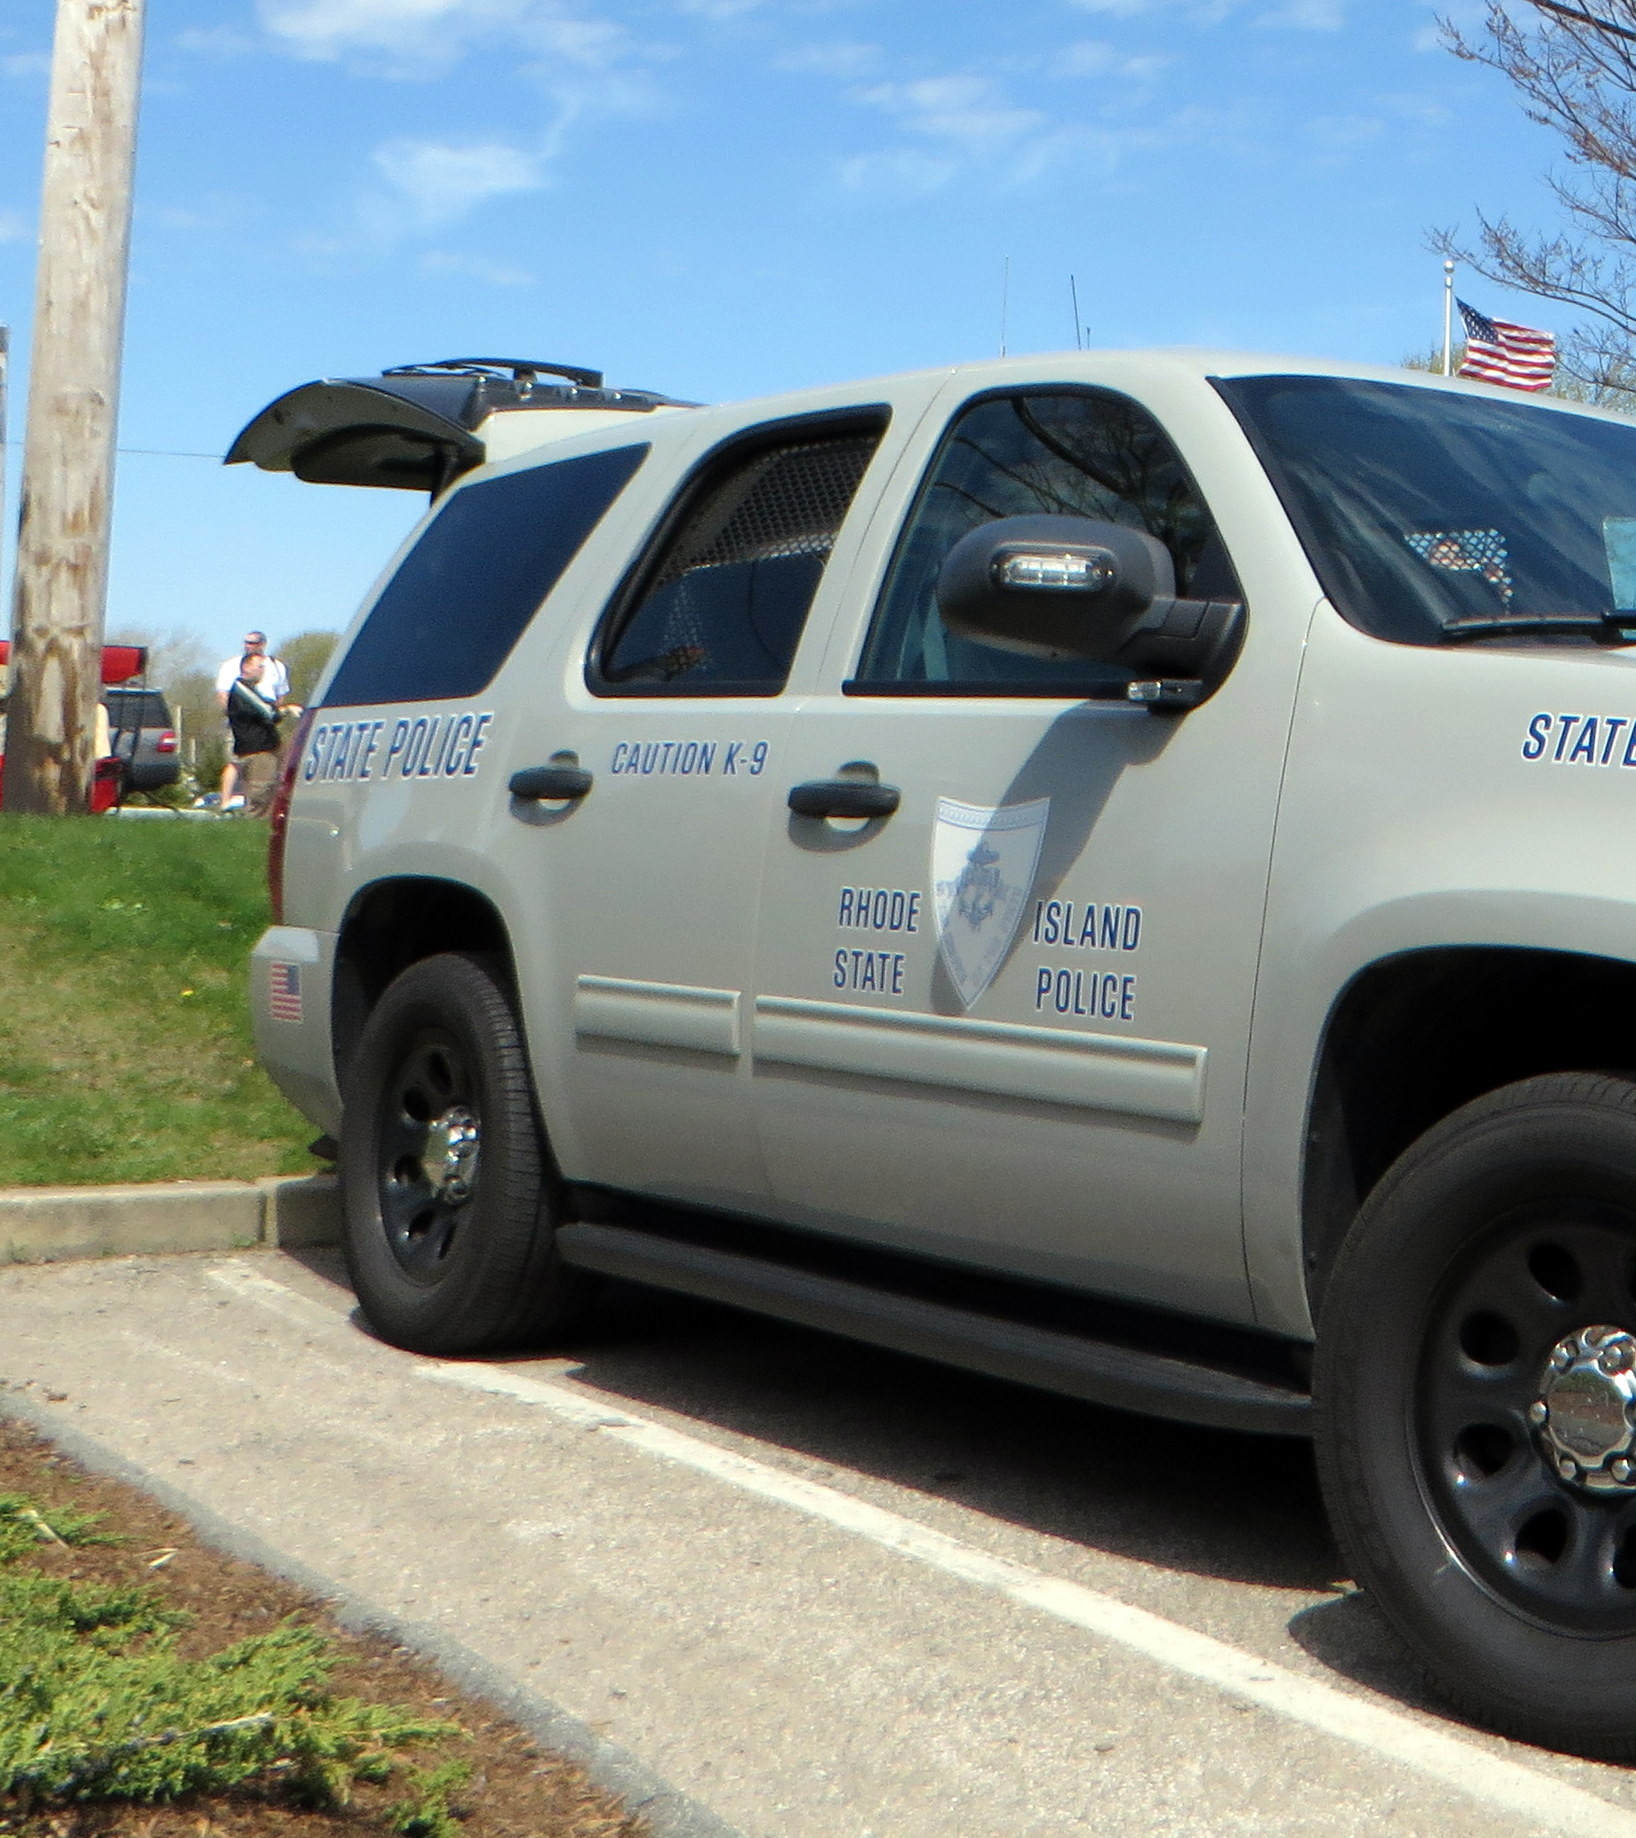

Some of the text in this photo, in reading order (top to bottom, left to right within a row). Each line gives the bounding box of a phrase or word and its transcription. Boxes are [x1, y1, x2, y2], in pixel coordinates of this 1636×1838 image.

[304, 711, 495, 784] STATE POLICE
[611, 740, 769, 776] CAUTION K-9
[839, 887, 921, 932] RHODE
[1033, 900, 1142, 951] ISLAND
[833, 949, 1136, 1021] STATE POLICE
